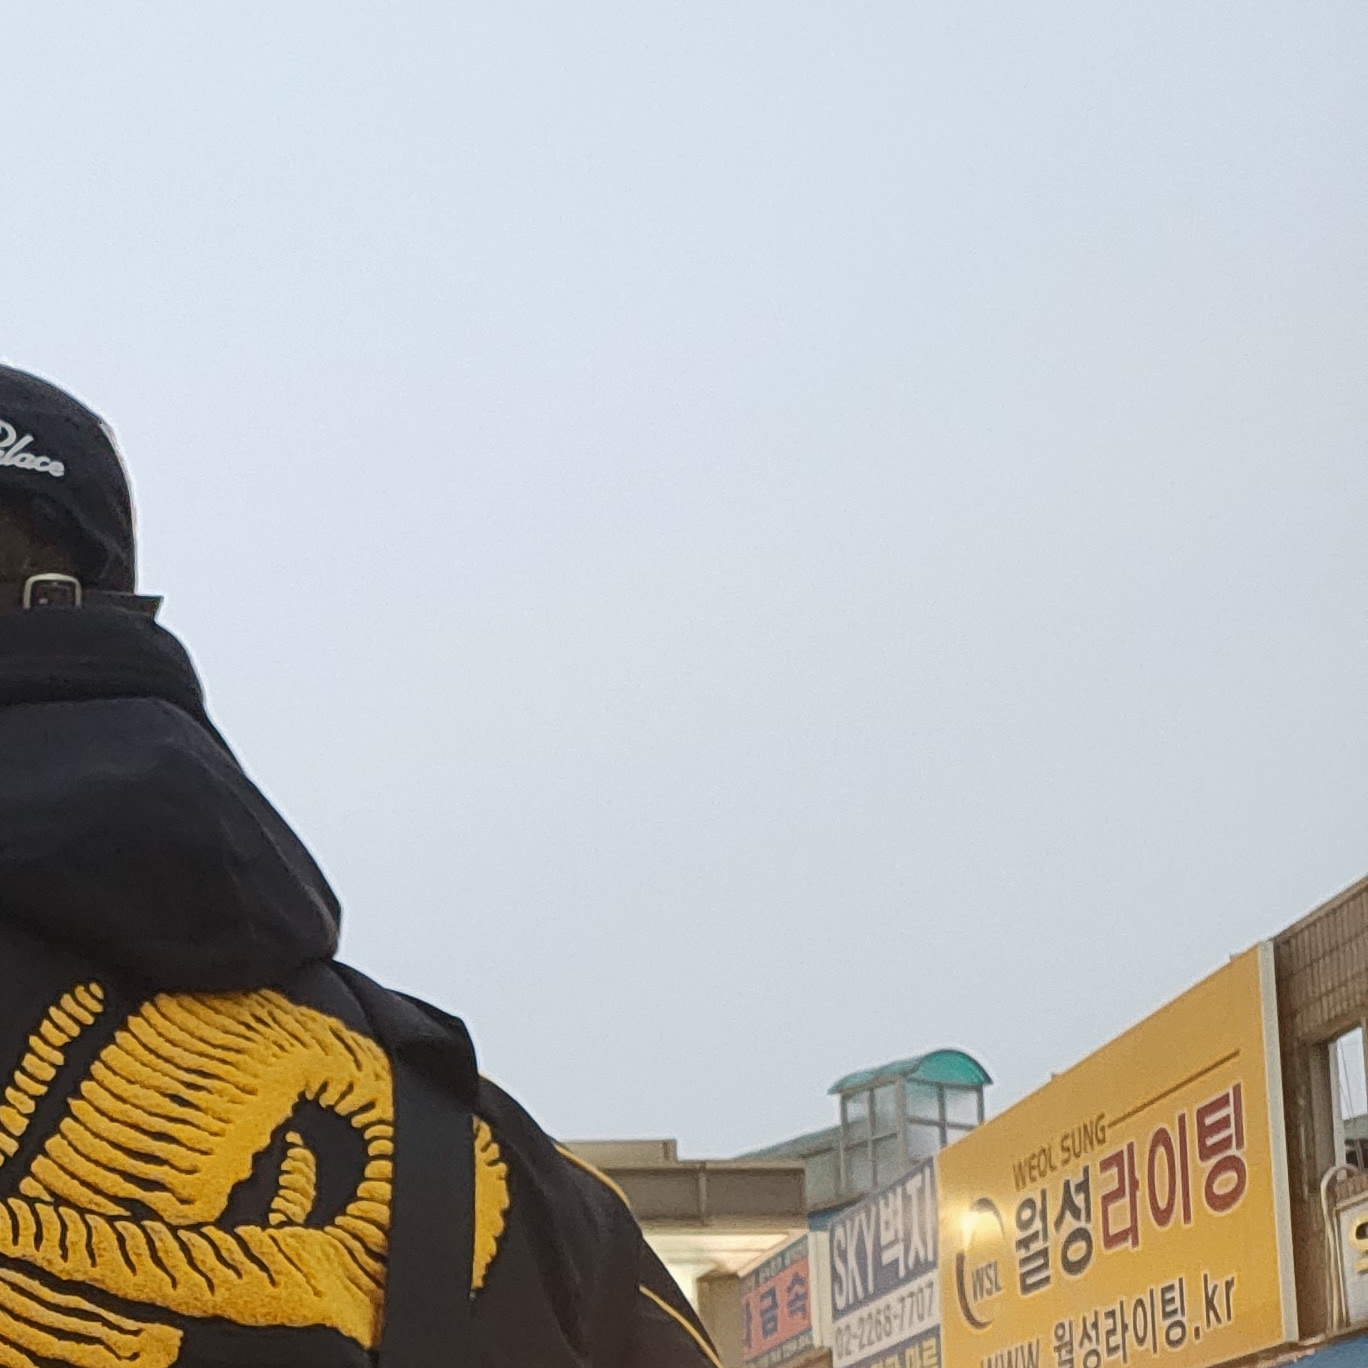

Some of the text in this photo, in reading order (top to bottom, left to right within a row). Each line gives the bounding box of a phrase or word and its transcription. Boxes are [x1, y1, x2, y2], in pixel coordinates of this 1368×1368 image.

[1011, 1112, 1107, 1191] WEOL SUNG
[1015, 1081, 1247, 1296] 월성라이팅
[971, 1260, 1003, 1302] WSL
